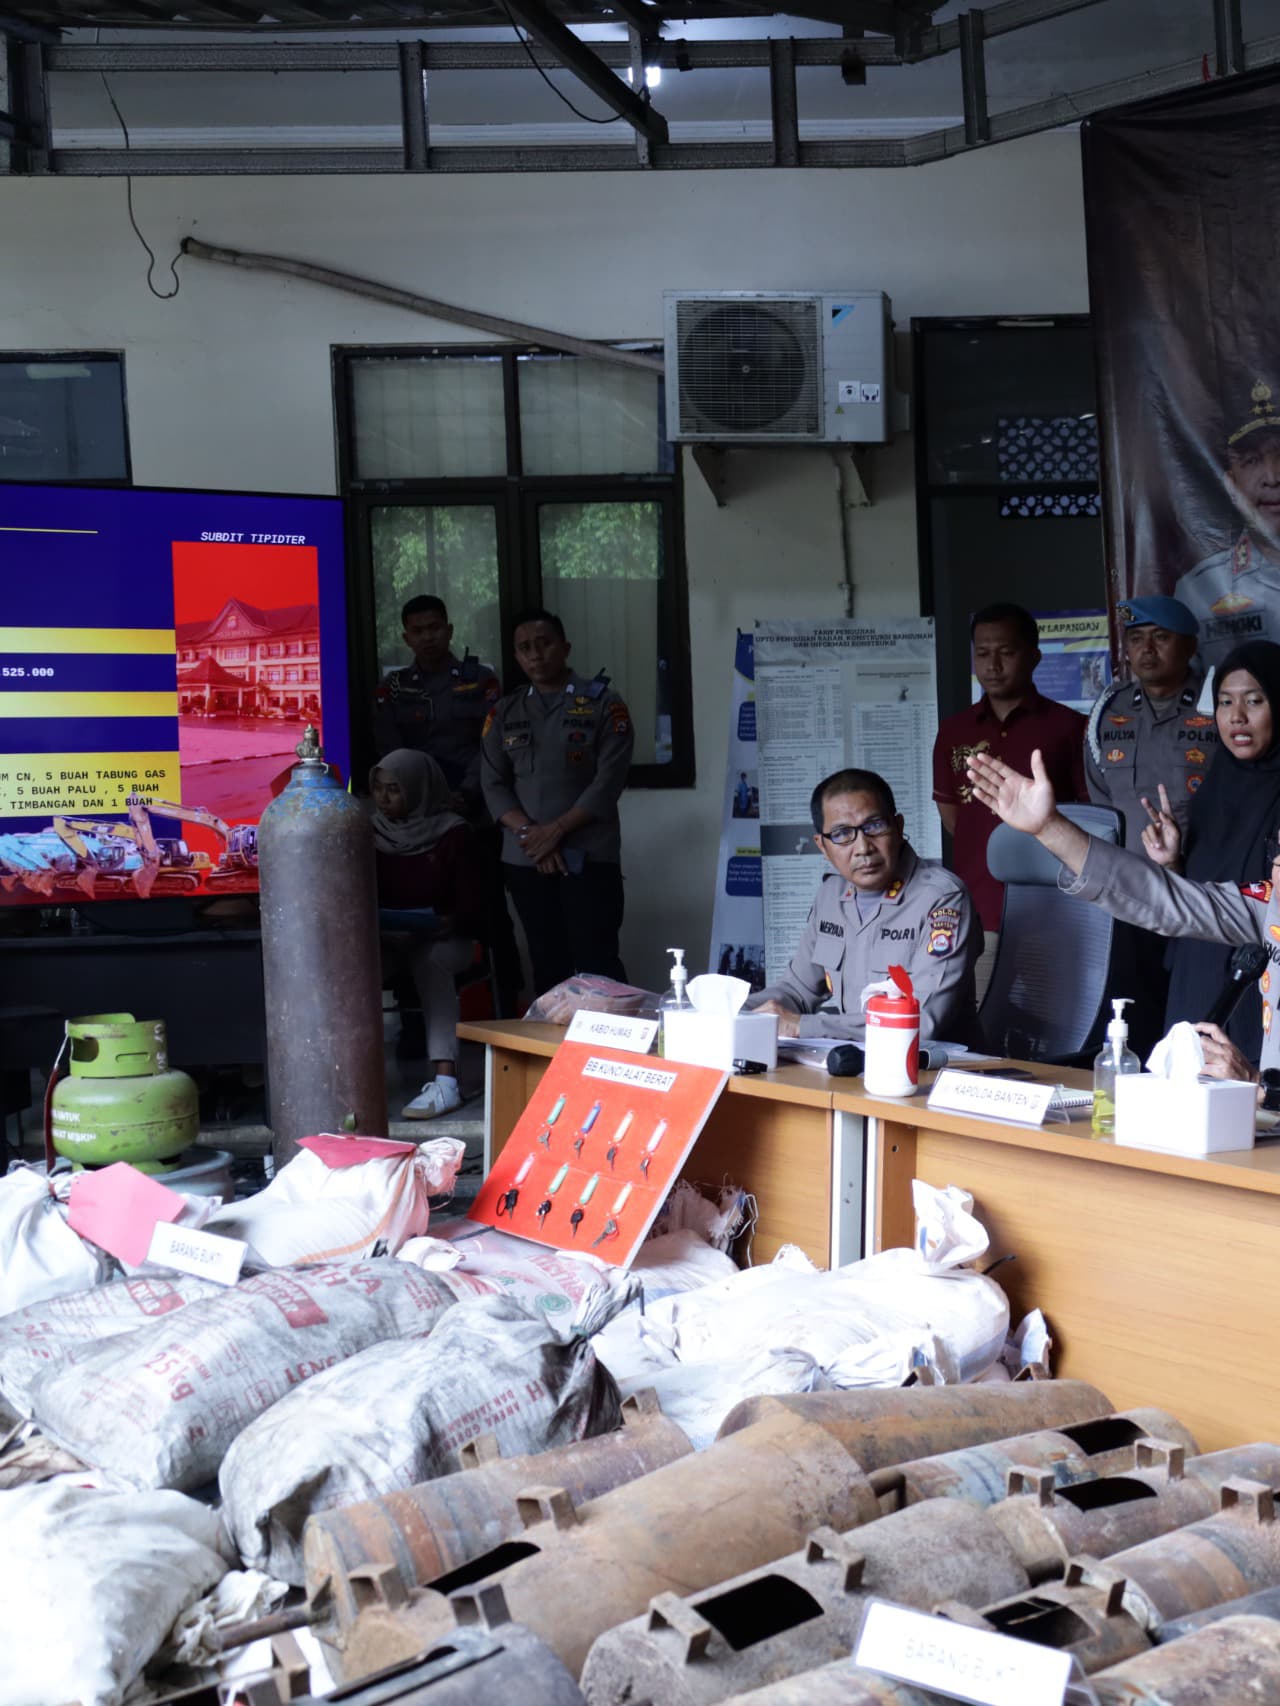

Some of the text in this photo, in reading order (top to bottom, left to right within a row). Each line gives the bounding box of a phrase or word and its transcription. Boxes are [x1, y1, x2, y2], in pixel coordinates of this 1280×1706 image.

[200, 531, 306, 545] SUBDIT TIPIDTER
[1047, 622, 1100, 633] LAPANGAN
[2, 666, 55, 678] 525.000
[46, 771, 53, 780] 5
[60, 771, 89, 780] BUAH
[96, 770, 138, 779] TABUNG
[145, 769, 166, 778] GAS
[17, 786, 24, 795] 5
[32, 786, 61, 795] BUAH
[68, 785, 96, 794] PALU
[117, 784, 125, 793] 5
[132, 783, 159, 793] BUAH
[10, 799, 75, 810] TIMBANGAN
[82, 799, 104, 808] DAN
[125, 797, 153, 807] BUAH
[644, 1072, 673, 1086] BERAT
[993, 1090, 1030, 1107] BANTEN
